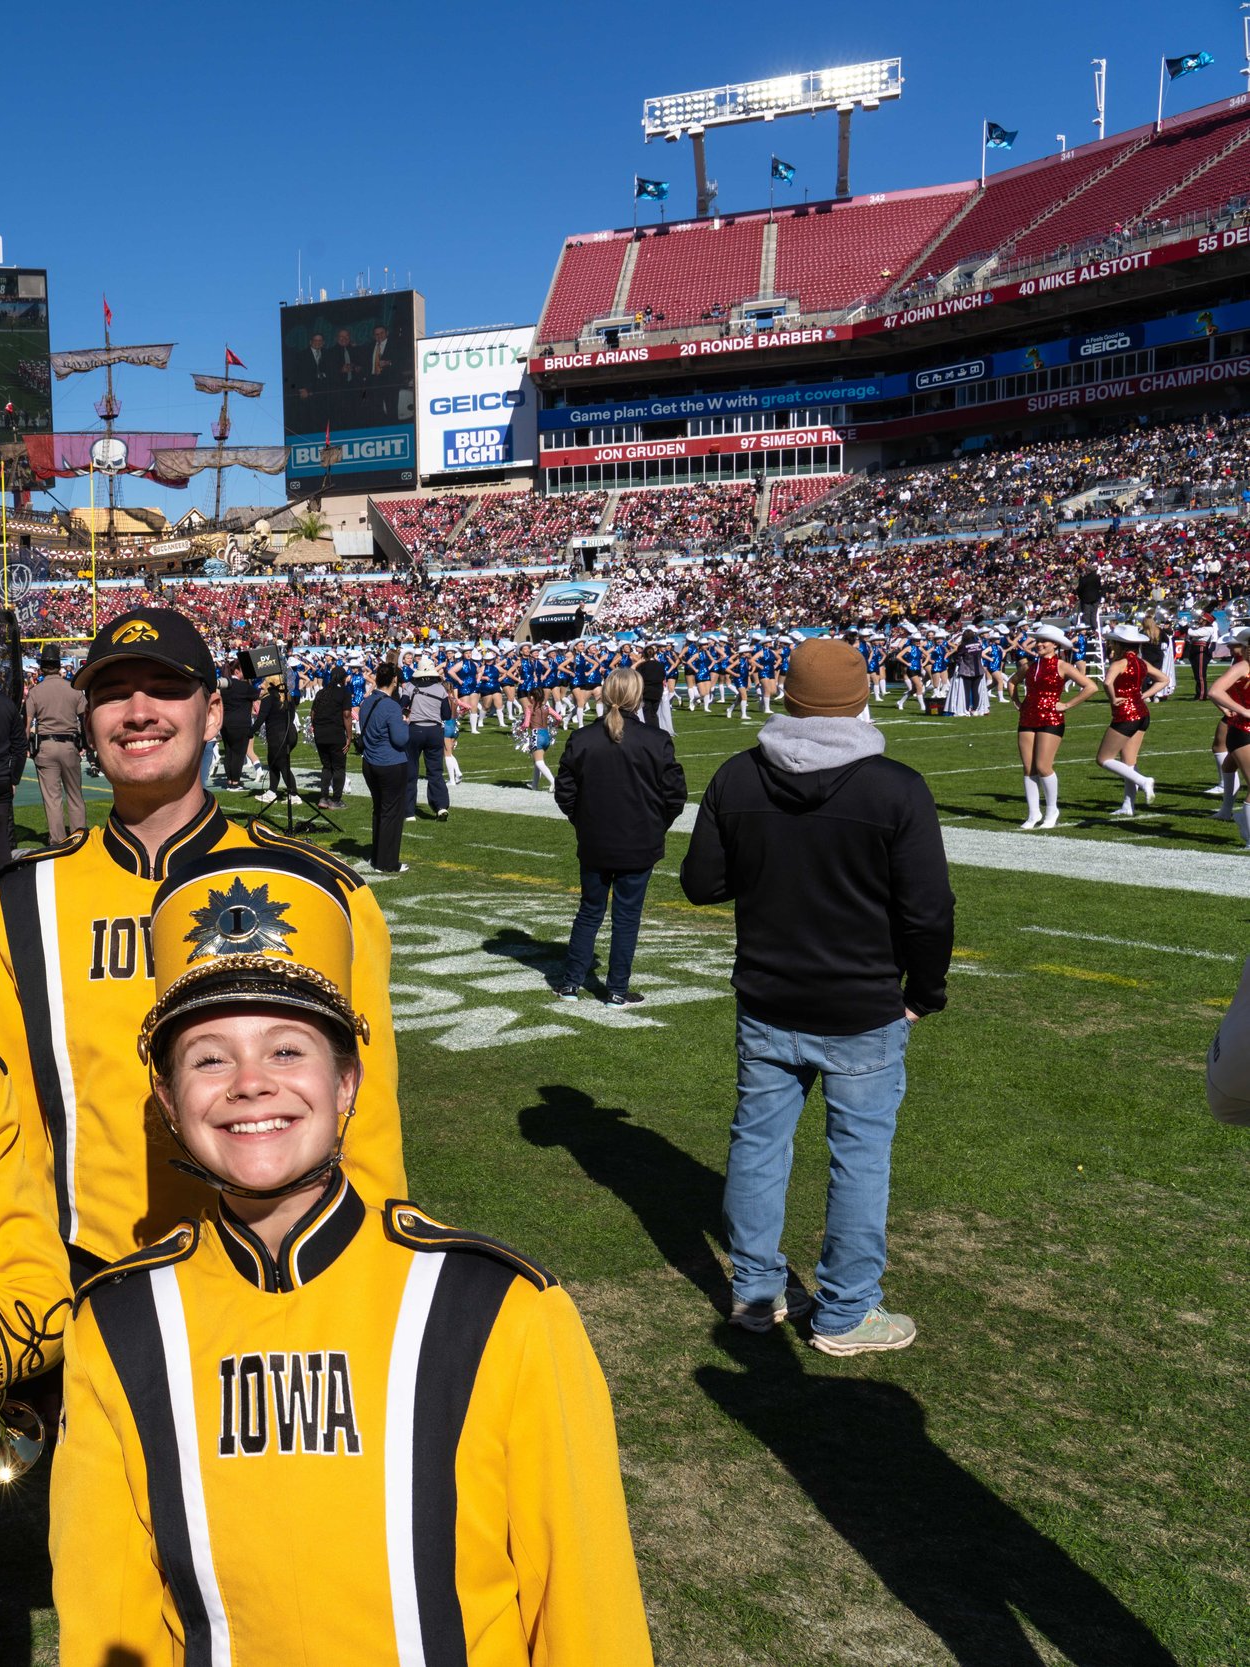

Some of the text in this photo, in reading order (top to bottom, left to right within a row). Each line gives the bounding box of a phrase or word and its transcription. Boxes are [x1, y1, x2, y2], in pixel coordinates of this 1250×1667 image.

[1229, 95, 1247, 107] 340
[1060, 150, 1075, 161] 341
[869, 194, 886, 203] 342
[1197, 227, 1250, 253] 55 DE
[1019, 252, 1152, 296] 40 MIKE ALSTOTT
[884, 293, 982, 329] 47 JOHN LYNCH
[680, 342, 697, 356] 20
[758, 329, 823, 348] BARBER
[1080, 336, 1131, 356] GEICO
[544, 348, 649, 370] BRUCE ARIANS
[1027, 361, 1250, 412] SUPER BOWL CHAMPIONS
[429, 389, 526, 416] GEICO
[570, 385, 880, 423] Game plan: Get the W with great coverage.
[455, 429, 501, 449] BUD
[740, 428, 858, 449] 97 SIMEON RICE
[296, 439, 405, 466] BU LIGHT
[447, 444, 510, 466] LIGHT
[594, 443, 686, 462] JON GRUDEN
[229, 907, 245, 935] I
[88, 915, 155, 982] IO
[217, 1350, 363, 1459] IOWA
